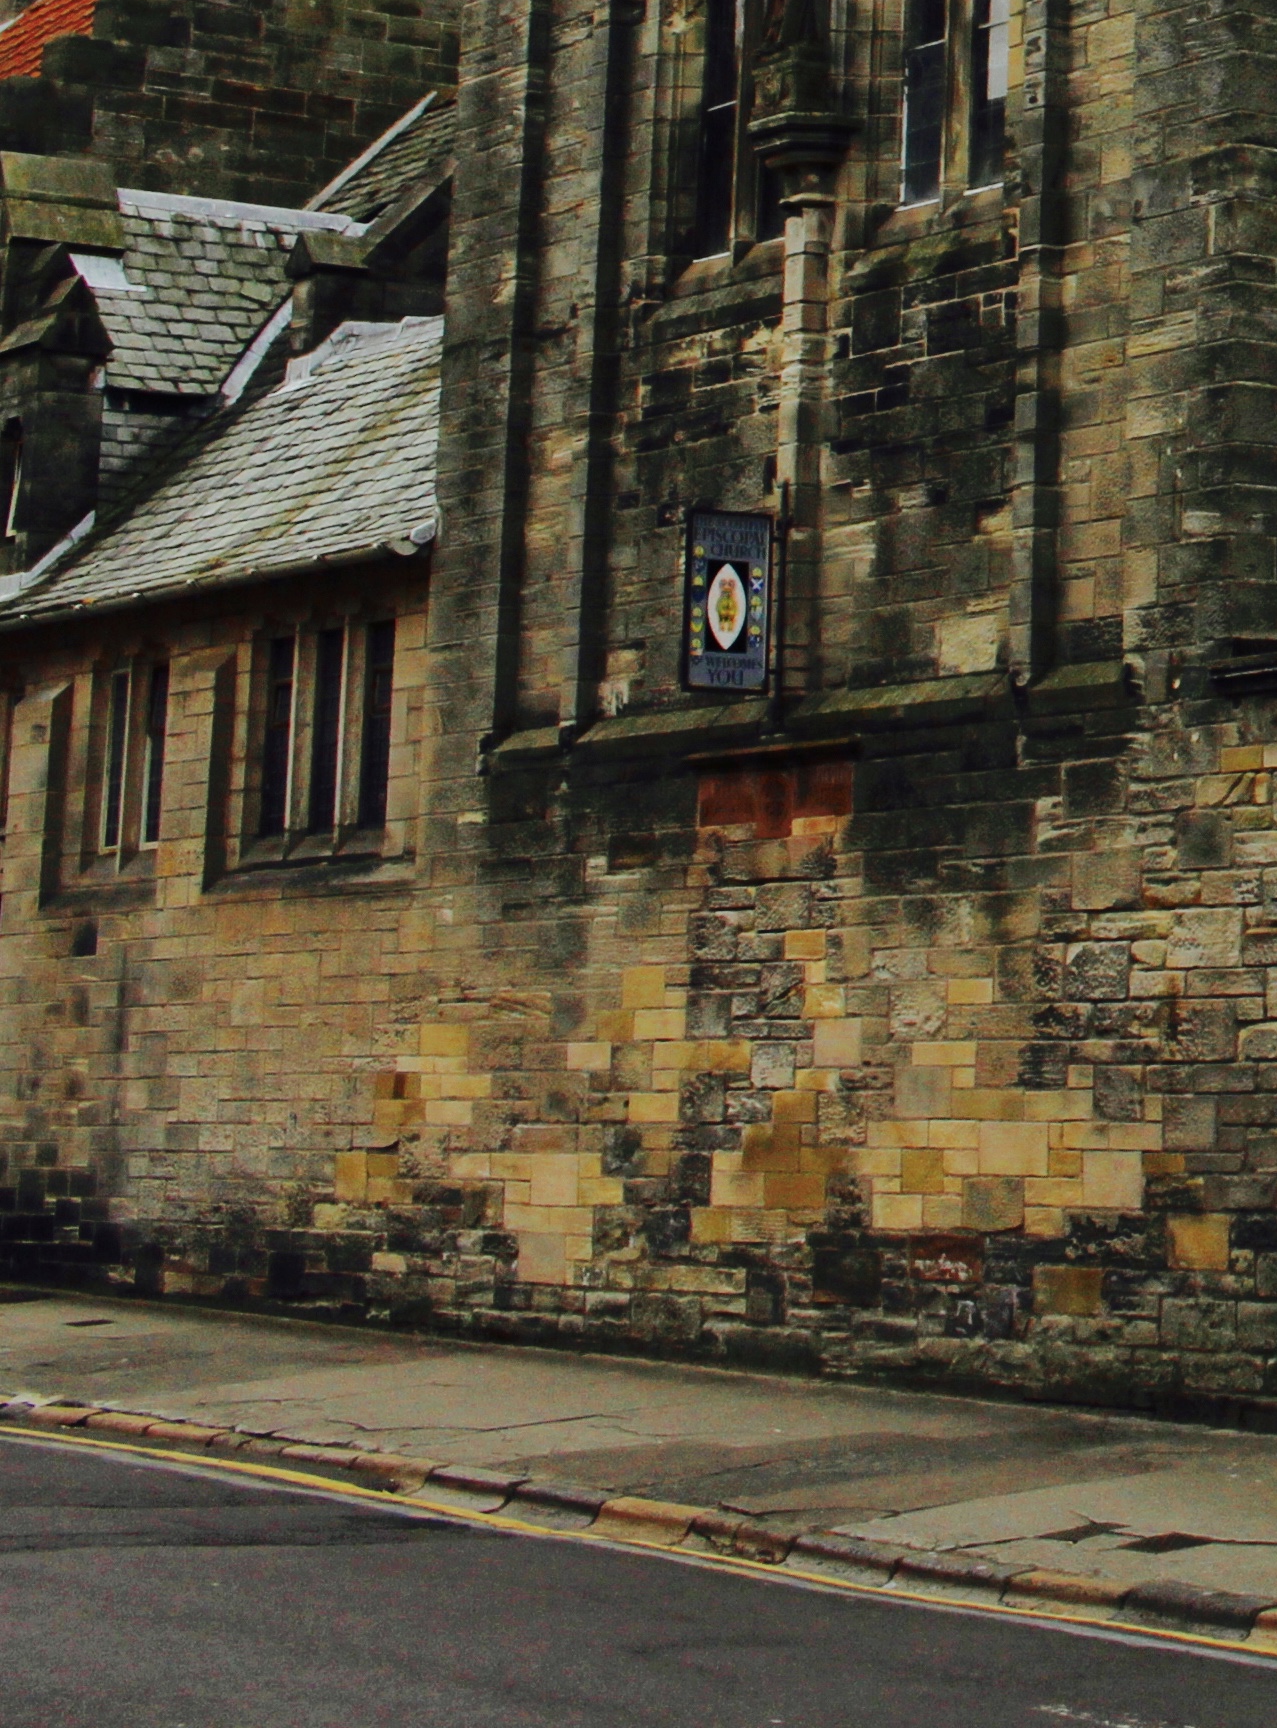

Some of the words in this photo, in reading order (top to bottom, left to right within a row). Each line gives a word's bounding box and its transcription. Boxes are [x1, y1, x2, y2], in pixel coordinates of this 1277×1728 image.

[694, 527, 766, 547] EPISCOPAL
[710, 542, 767, 560] CHURCH
[705, 655, 763, 670] WELCOMES
[708, 668, 744, 685] YOU
